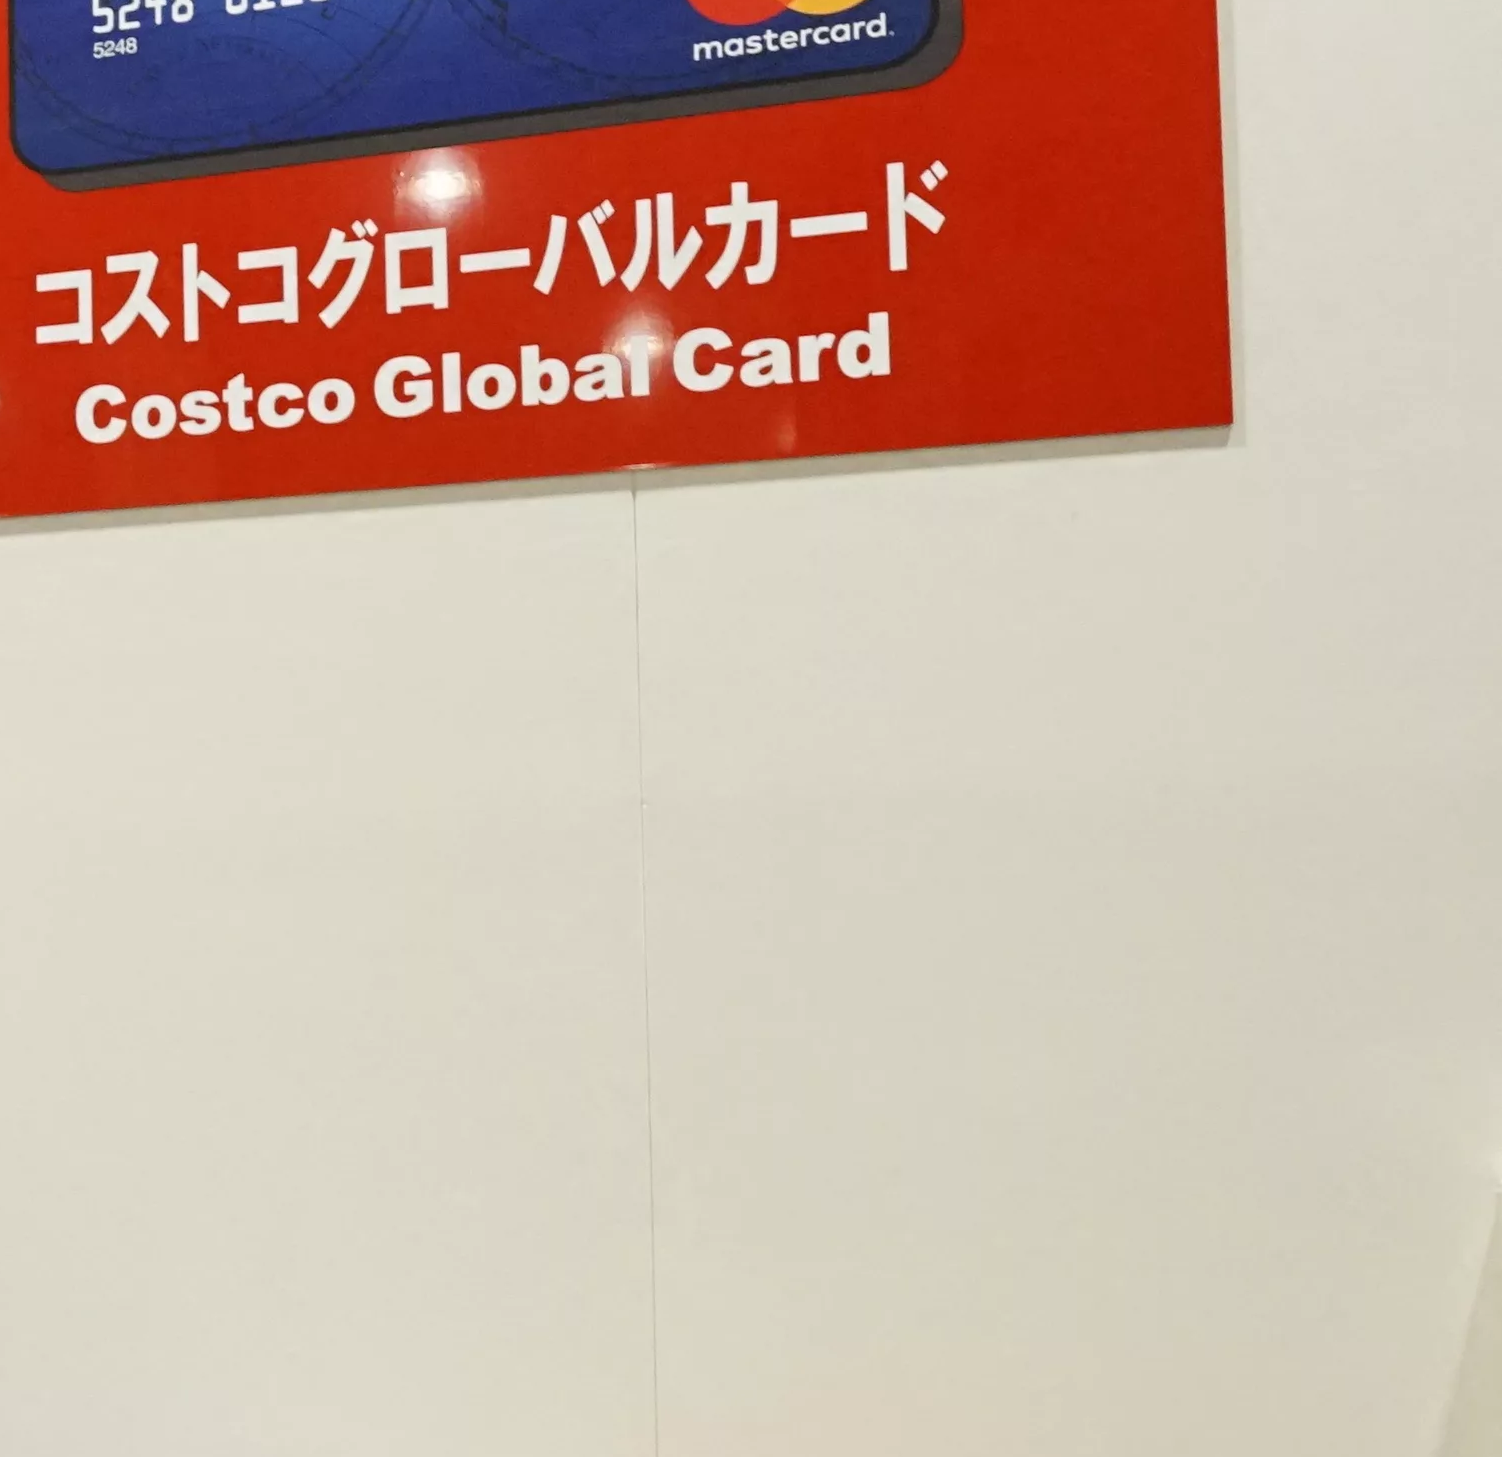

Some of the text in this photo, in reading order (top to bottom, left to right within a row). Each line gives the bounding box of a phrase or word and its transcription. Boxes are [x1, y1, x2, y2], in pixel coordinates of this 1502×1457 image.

[93, 37, 138, 60] 5248
[692, 13, 888, 62] mastercard
[35, 160, 949, 345] コストコグローバルカード
[74, 312, 892, 444] Costco Global Card
